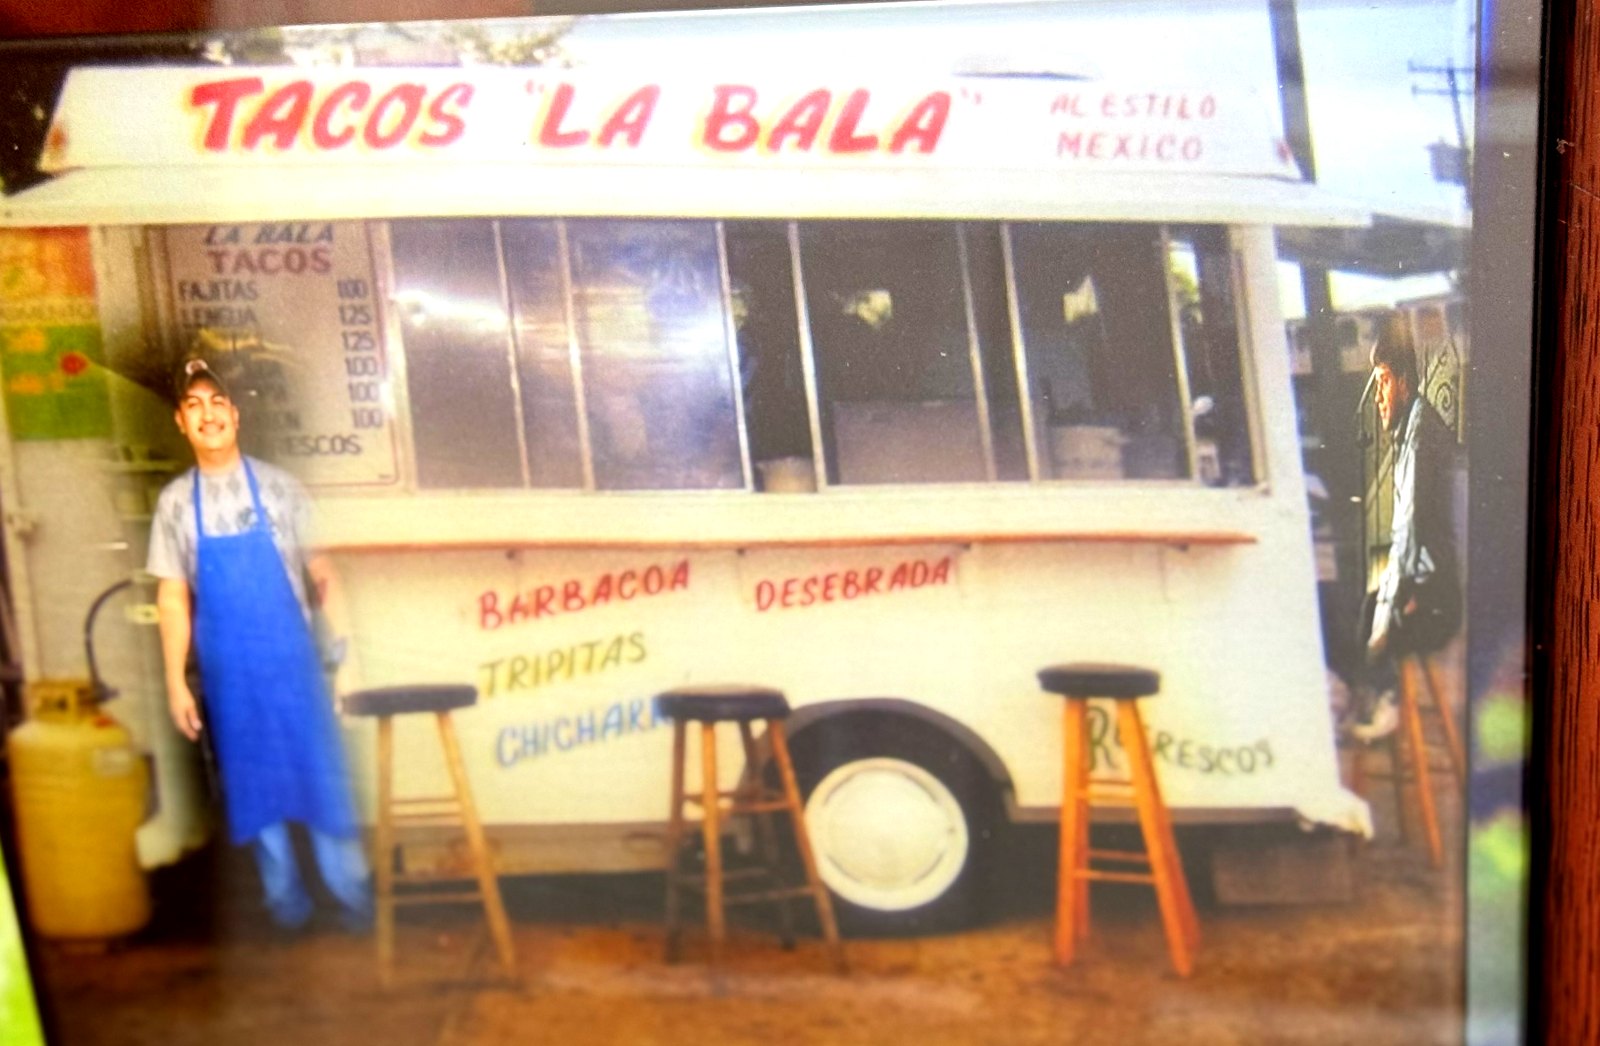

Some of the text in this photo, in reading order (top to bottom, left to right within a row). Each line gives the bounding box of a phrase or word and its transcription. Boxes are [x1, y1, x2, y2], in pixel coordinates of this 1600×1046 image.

[188, 77, 475, 152] TACOS
[1050, 93, 1217, 119] AL ESTILO
[1057, 131, 1203, 161] MEXICO
[204, 224, 243, 246] LA
[206, 248, 332, 275] TACOS
[177, 279, 368, 301] FAJITAS 100
[339, 304, 372, 326] 125
[341, 330, 376, 352] 125
[344, 356, 378, 377] 100
[347, 381, 380, 403] 100
[351, 408, 384, 429] 100
[479, 559, 692, 630] BARBACOA
[754, 556, 952, 612] DESEBRADA
[479, 632, 647, 698] TRIPITAS
